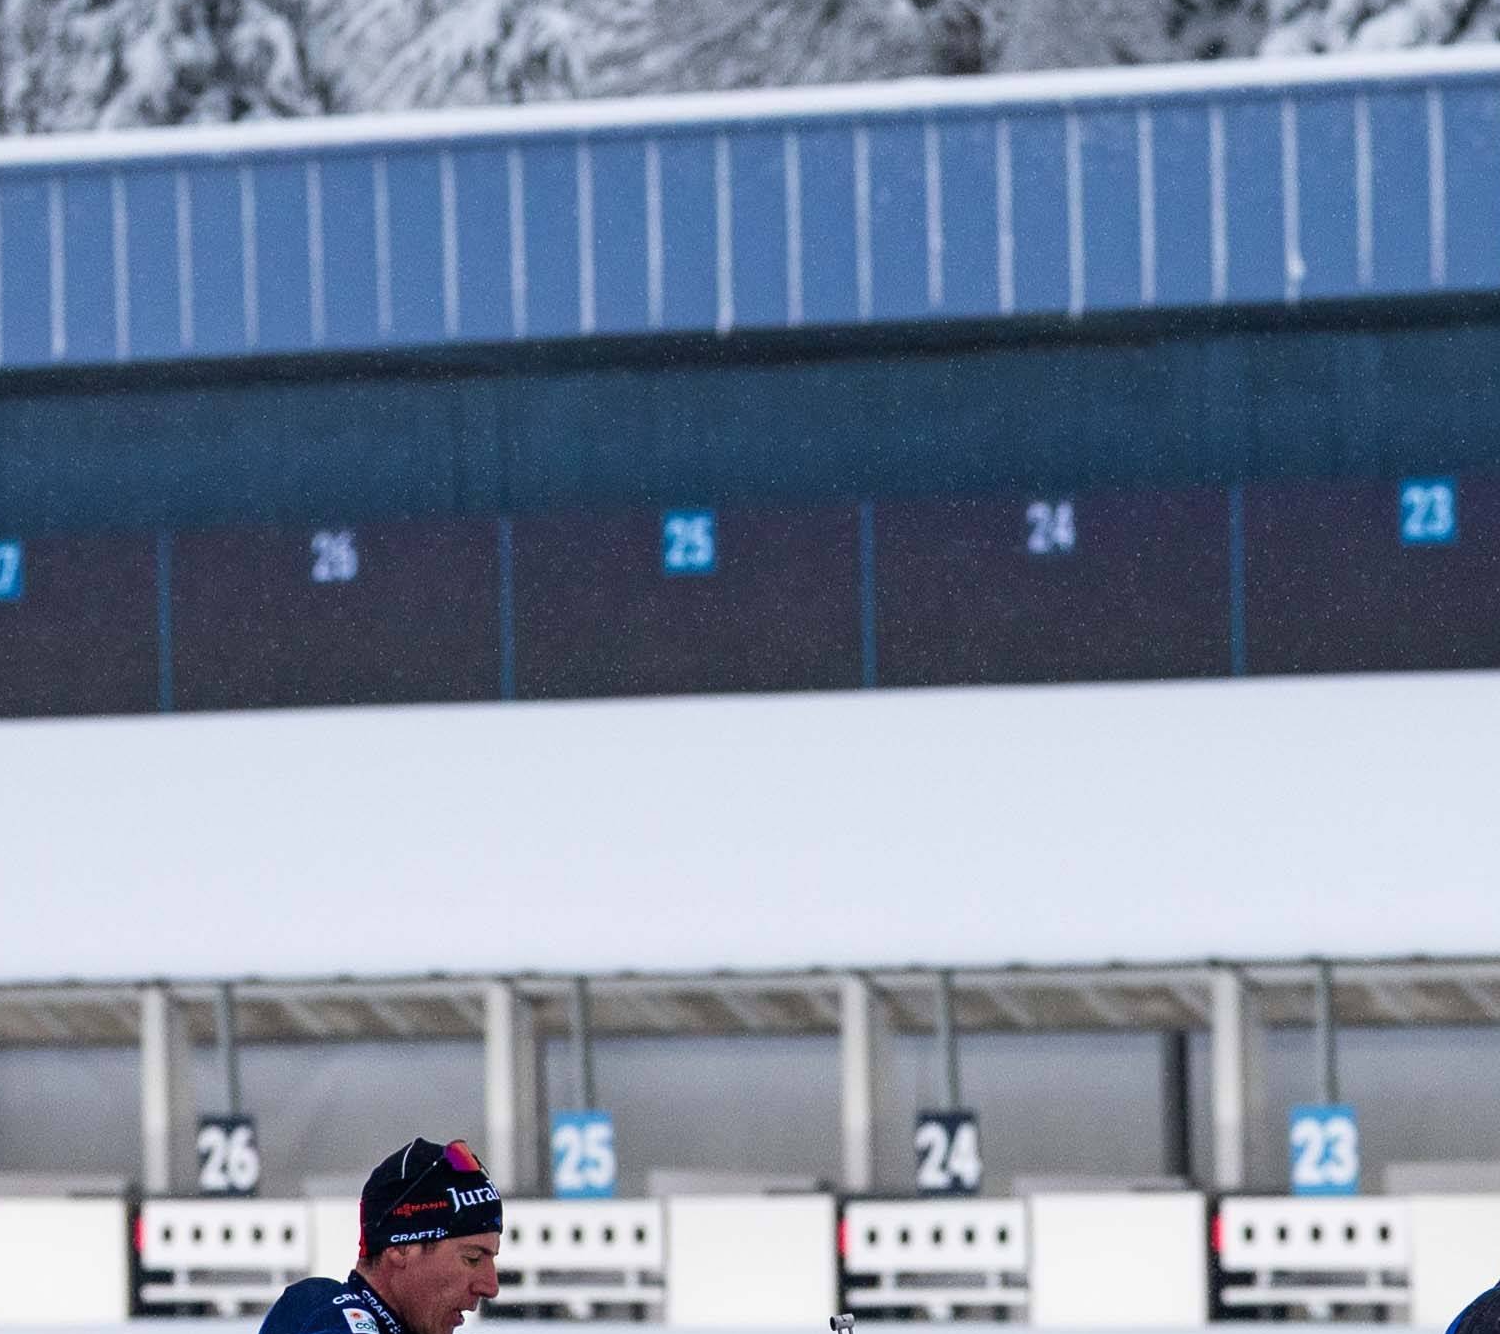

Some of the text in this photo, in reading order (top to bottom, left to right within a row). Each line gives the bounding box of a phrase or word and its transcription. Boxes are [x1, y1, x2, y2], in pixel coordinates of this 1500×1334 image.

[1026, 502, 1076, 552] 24
[1402, 485, 1454, 538] 23
[665, 517, 714, 566] 25
[200, 1125, 259, 1191] 26
[553, 1124, 615, 1189] 25
[917, 1122, 981, 1189] 24
[1292, 1117, 1359, 1186] 23
[390, 1230, 435, 1242] CRAFT
[333, 1293, 360, 1305] CRA
[362, 1289, 396, 1330] CRAFT
